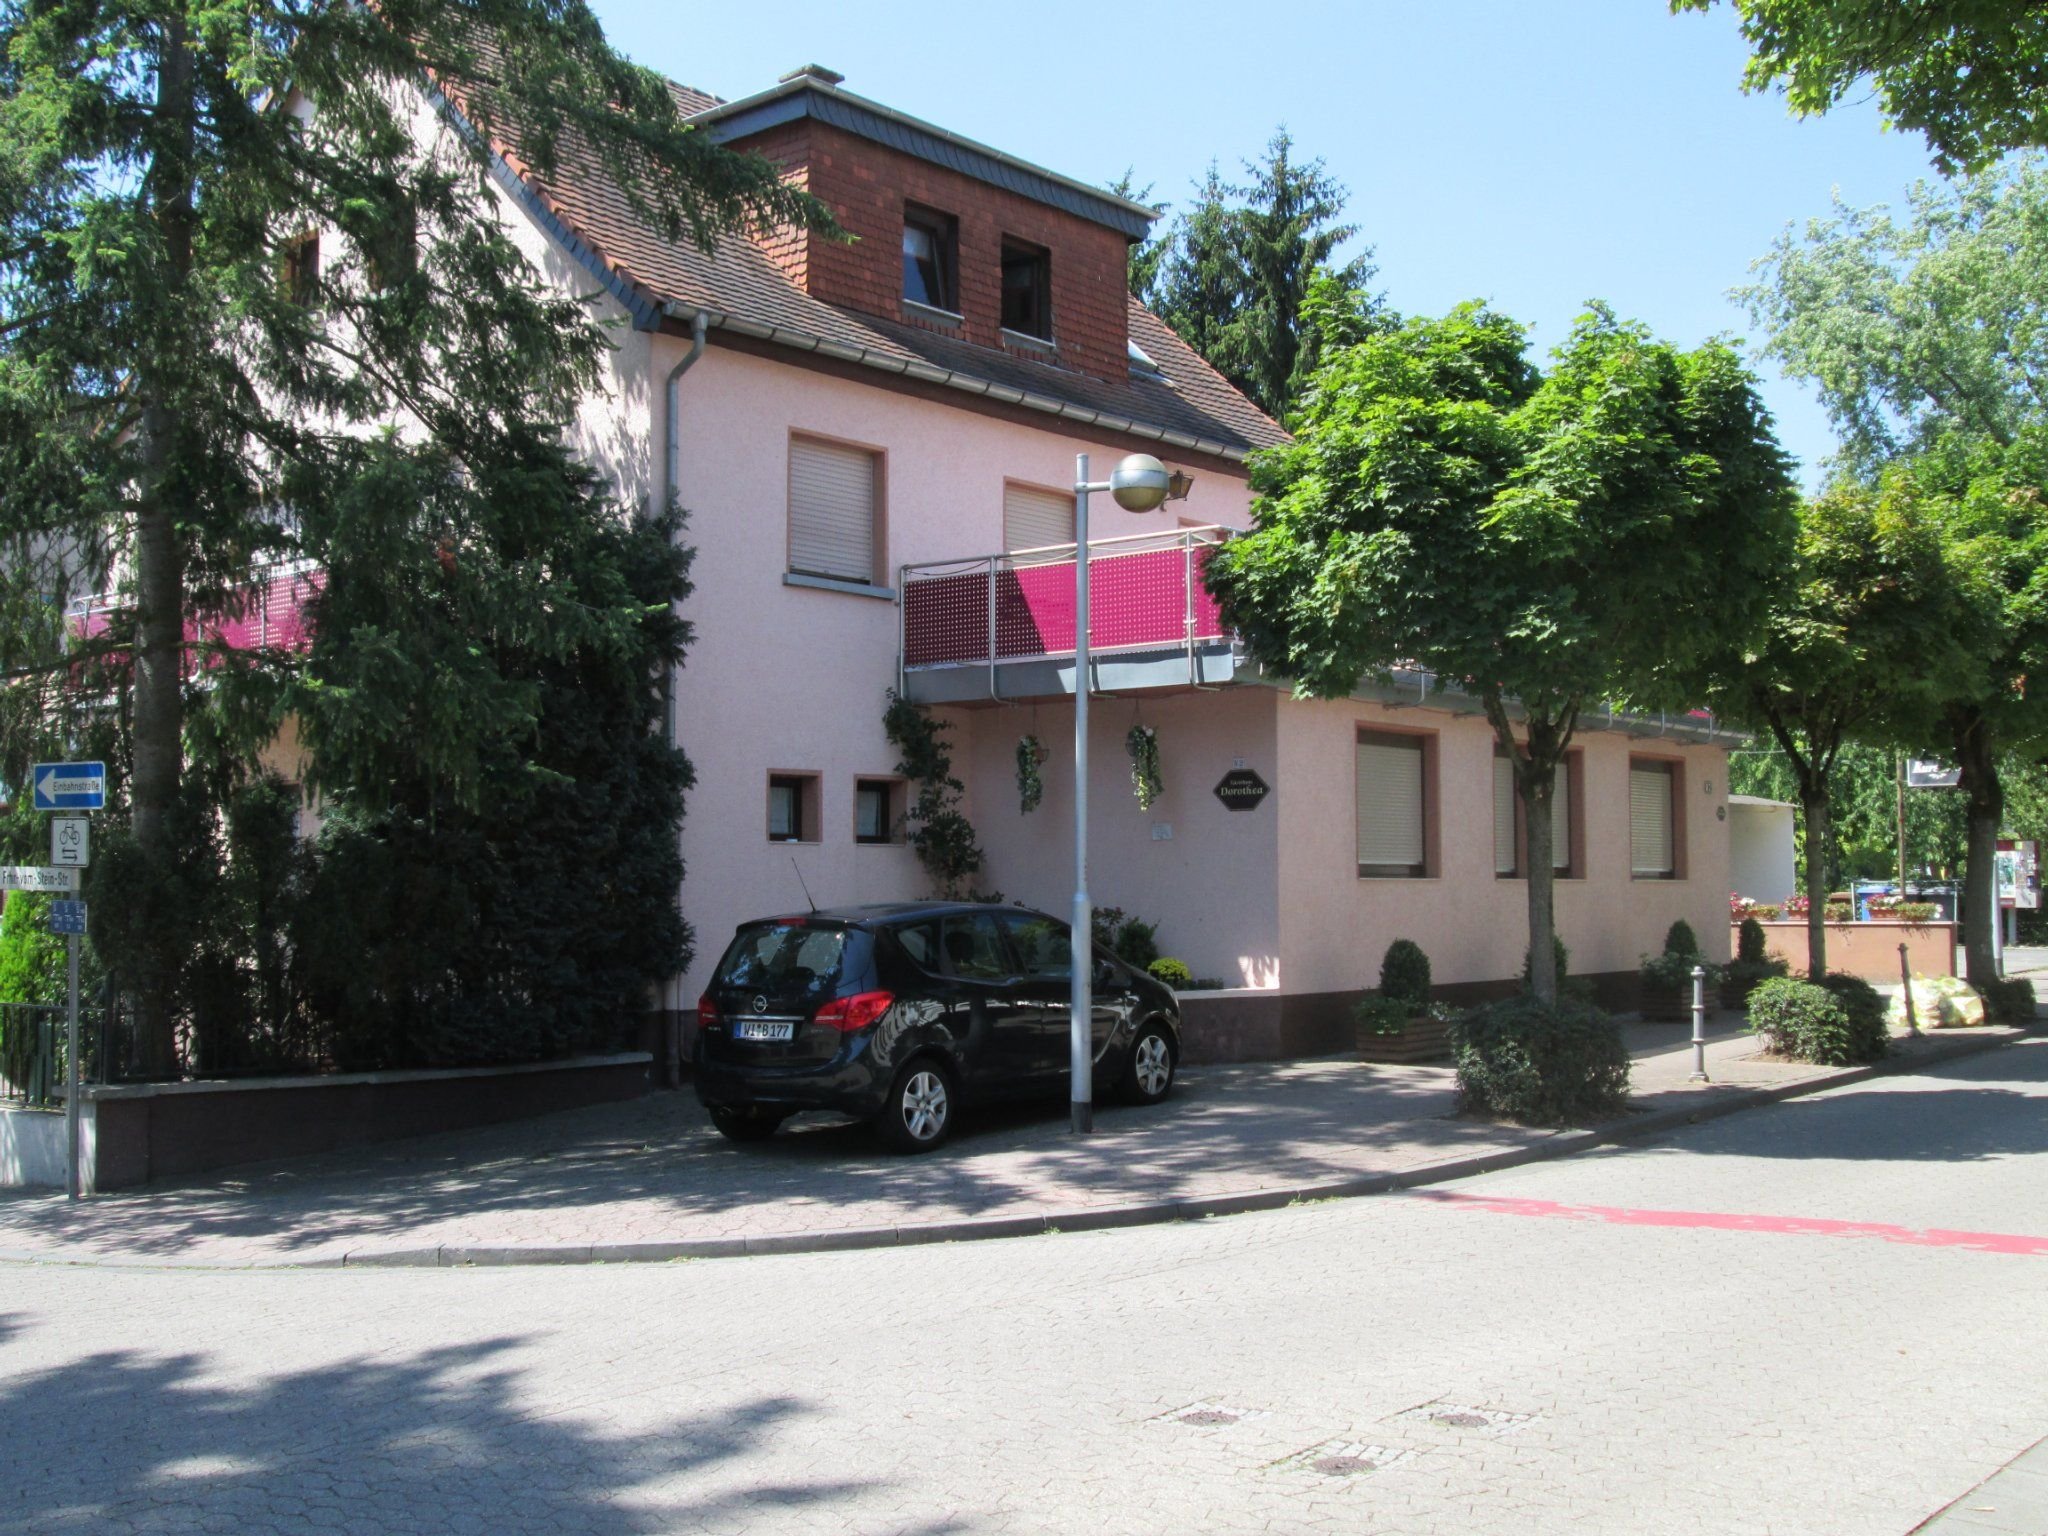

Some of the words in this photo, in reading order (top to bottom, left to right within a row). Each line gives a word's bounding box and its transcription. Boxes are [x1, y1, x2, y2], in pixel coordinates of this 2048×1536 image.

[53, 780, 100, 791] Einbahnstraße
[1220, 786, 1263, 796] Dorothea
[744, 1023, 755, 1036] WI
